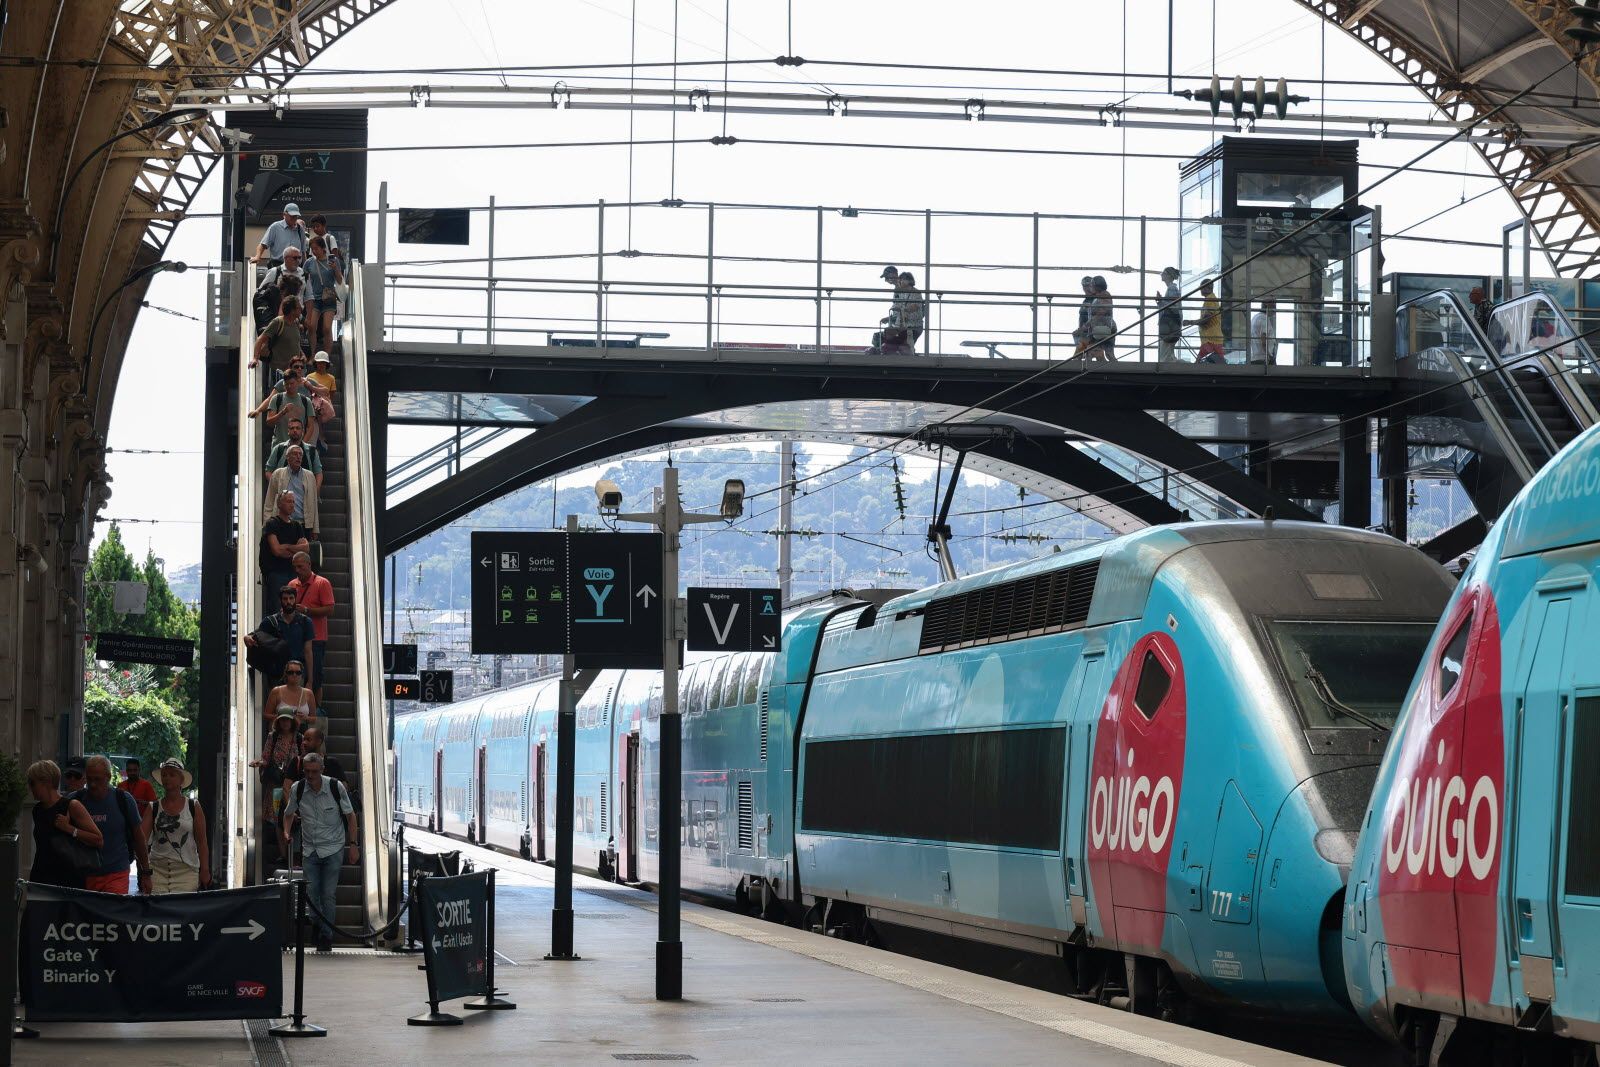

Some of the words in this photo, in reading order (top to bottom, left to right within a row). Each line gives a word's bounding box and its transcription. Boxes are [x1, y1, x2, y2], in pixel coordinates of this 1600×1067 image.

[288, 156, 299, 169] A
[318, 156, 330, 170] Y
[528, 557, 555, 566] Sortie
[587, 568, 610, 579] Voie
[585, 584, 614, 617] Y
[763, 601, 774, 613] A
[703, 602, 740, 645] V
[113, 649, 139, 657] Contact
[165, 644, 193, 653] ESCALE
[425, 672, 434, 687] 2
[439, 679, 448, 695] V
[425, 687, 434, 701] 6
[1212, 890, 1233, 917] 777
[436, 898, 473, 928] SORTIE
[43, 923, 119, 942] ACCES
[126, 923, 182, 942] VOIE
[187, 923, 205, 941] Y
[43, 948, 83, 963] Gate
[87, 948, 99, 962] Y
[43, 968, 99, 983] Binario
[104, 969, 117, 983] Y
[236, 986, 265, 996] SNCF
